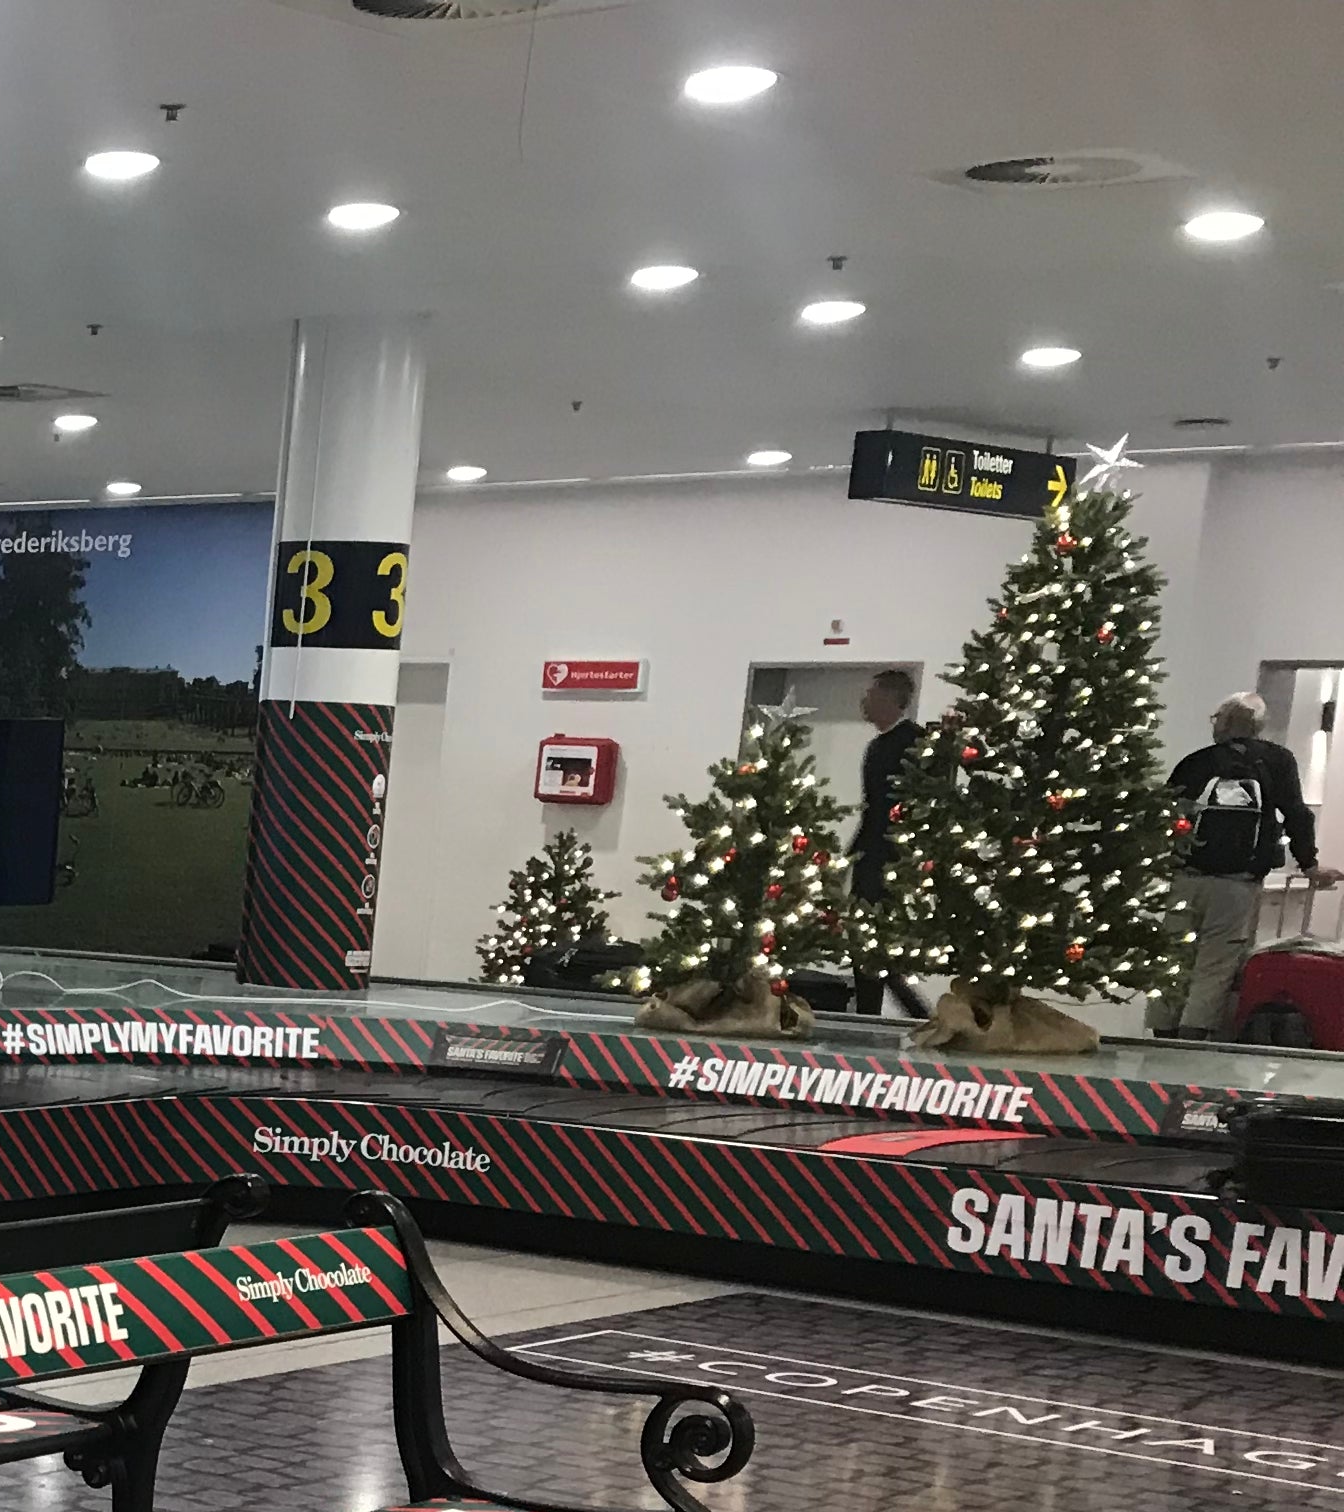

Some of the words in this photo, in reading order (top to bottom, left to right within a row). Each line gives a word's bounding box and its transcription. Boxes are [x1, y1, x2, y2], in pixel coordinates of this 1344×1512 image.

[973, 450, 1013, 474] Toiletter
[970, 476, 1004, 499] Toilets
[282, 550, 334, 635] 3
[372, 552, 408, 638] 3
[2, 1021, 321, 1059] #SIMPLYMYFAVORITE
[667, 1055, 1032, 1123] #SIMPLYMYFAVORITE
[253, 1126, 357, 1163] Simply
[360, 1133, 492, 1173] Chocolate
[946, 1188, 1210, 1284] SANTA'S
[236, 1272, 296, 1304] Simply
[295, 1262, 372, 1294] Chocolate
[625, 1347, 1344, 1479] #COPENHAG
